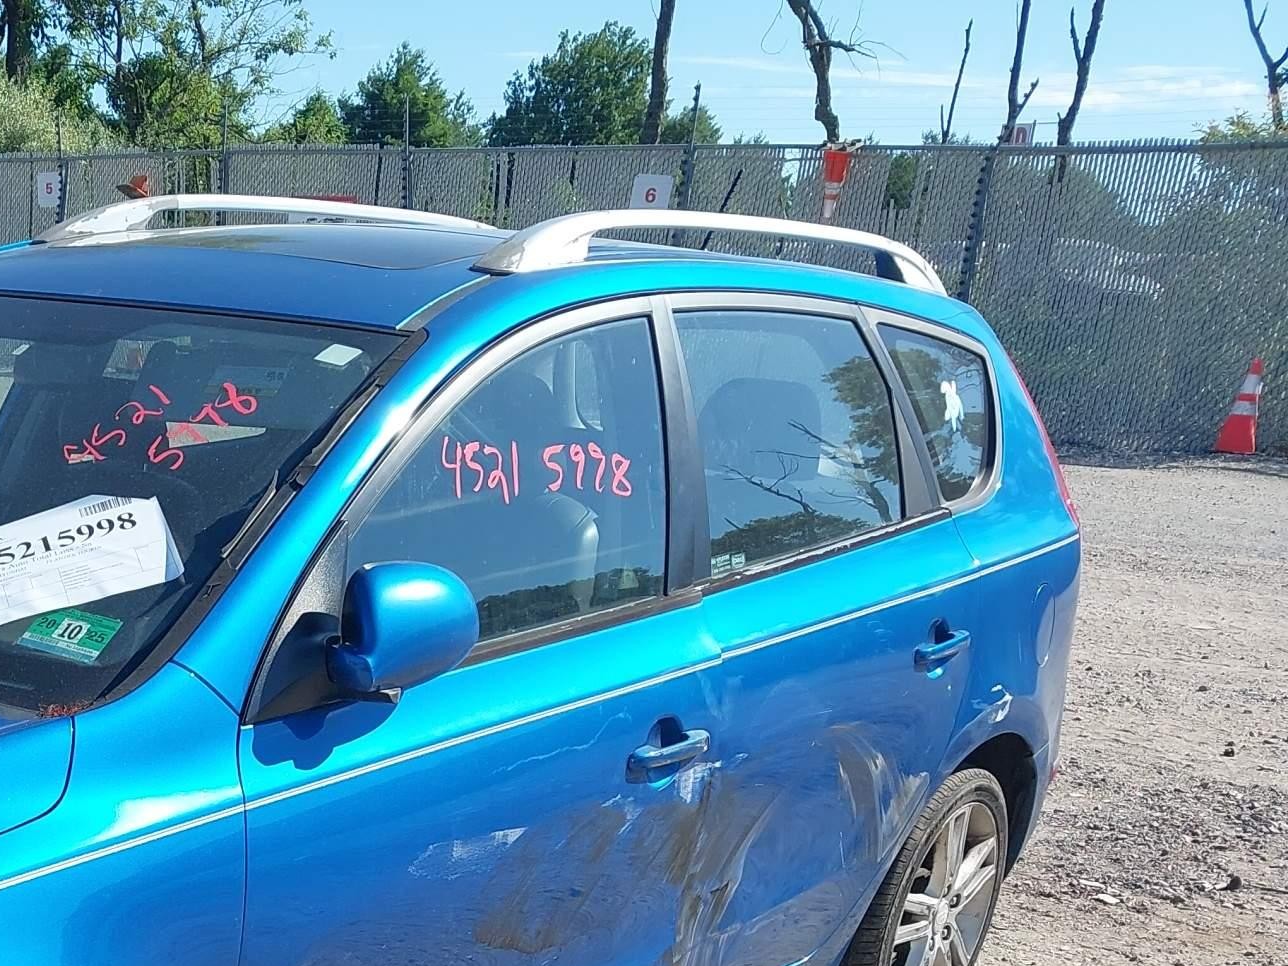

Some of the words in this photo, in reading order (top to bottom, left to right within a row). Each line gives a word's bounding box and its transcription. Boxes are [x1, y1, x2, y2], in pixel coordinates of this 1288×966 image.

[45, 182, 53, 195] 5
[645, 187, 657, 203] 6
[441, 436, 519, 504] 4521
[543, 441, 632, 497] 5998
[38, 617, 57, 630] 20
[57, 622, 83, 641] 10
[86, 630, 106, 644] 25
